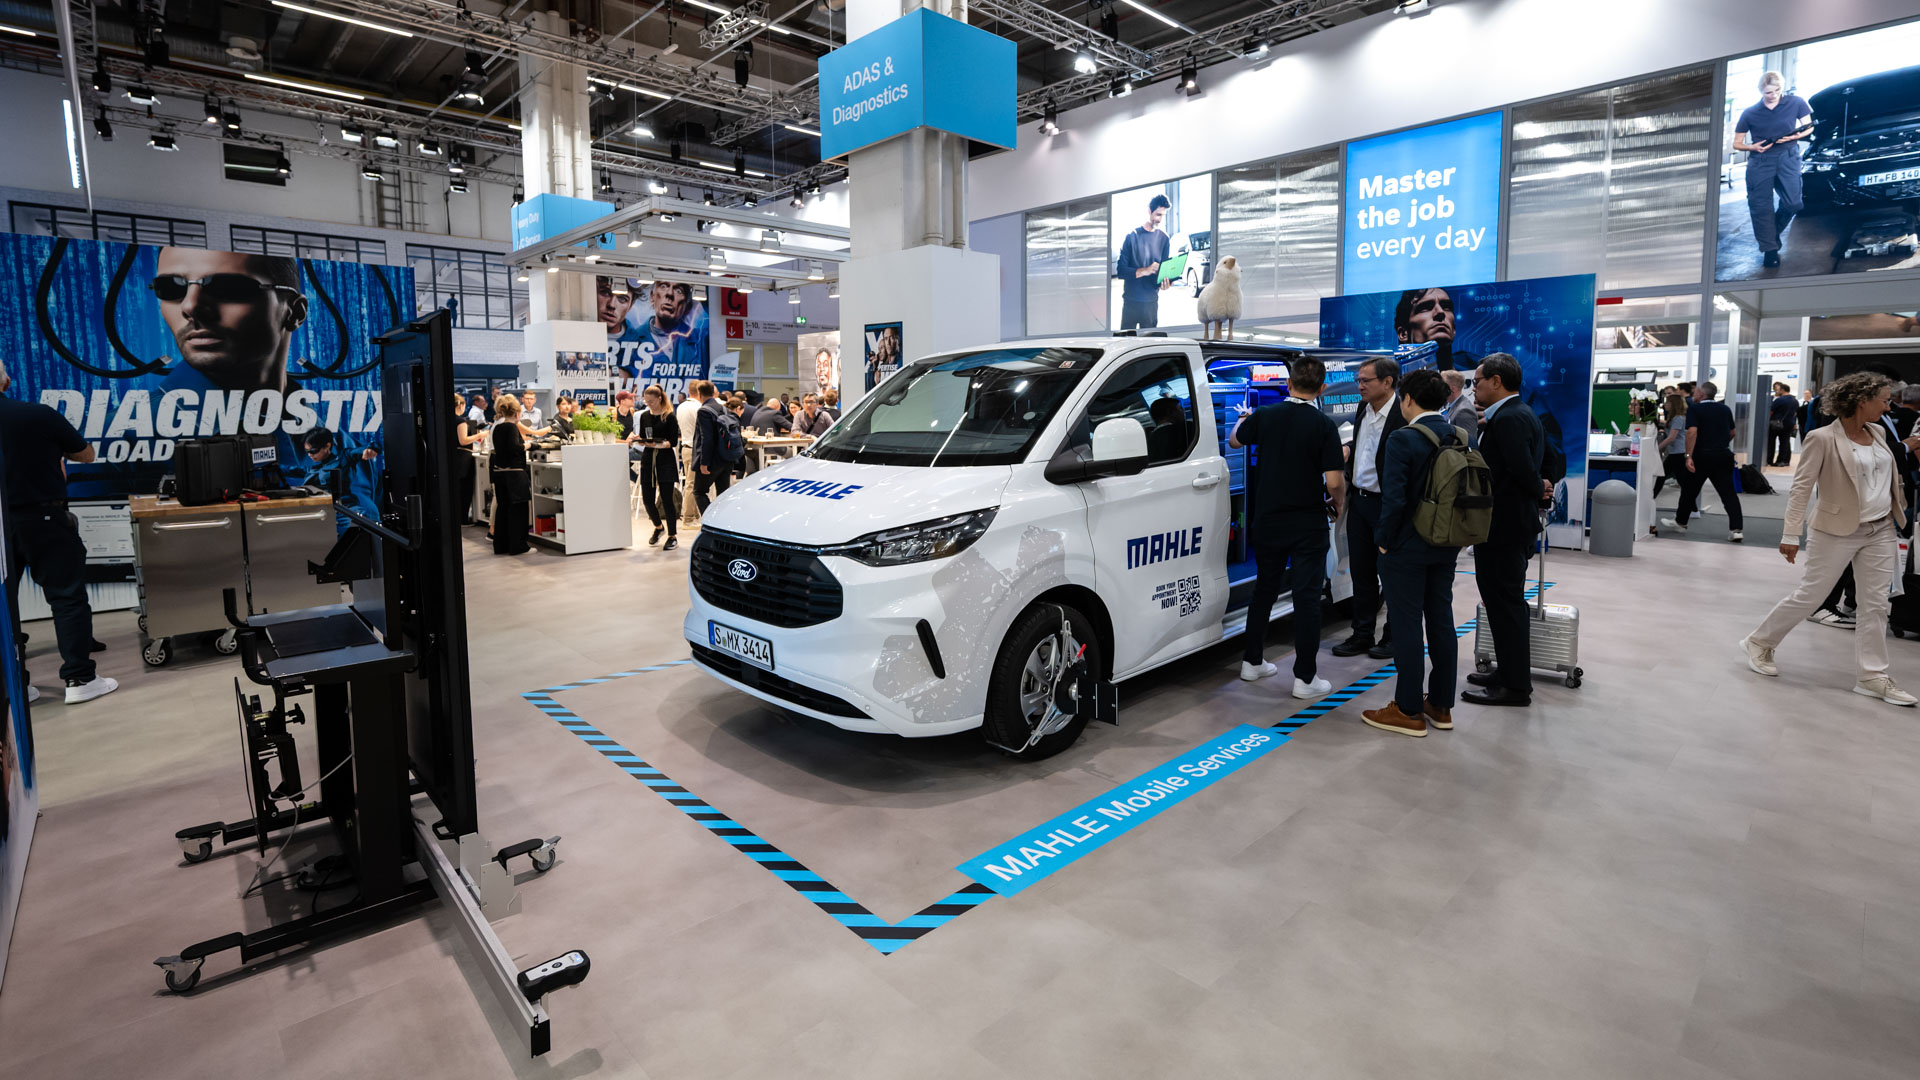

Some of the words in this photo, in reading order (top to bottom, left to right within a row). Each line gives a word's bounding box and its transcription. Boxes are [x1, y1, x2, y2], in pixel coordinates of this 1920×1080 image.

[843, 62, 881, 95] ADAS
[884, 56, 895, 76] &
[832, 83, 909, 125] Diagnostics
[1359, 166, 1457, 200] Master
[1866, 175, 1879, 184] HT
[1885, 173, 1898, 182] FB
[1357, 205, 1401, 230] the
[1407, 194, 1456, 228] job
[1356, 234, 1426, 259] every
[1434, 225, 1486, 252] day
[727, 288, 742, 311] C
[745, 329, 753, 337] 12
[607, 340, 655, 370] RTS
[651, 362, 675, 377] FOR
[678, 362, 702, 377] THE
[1332, 371, 1355, 383] CHANGE
[575, 392, 607, 401] EXPERTE
[1323, 395, 1340, 405] BRAKE
[1341, 393, 1362, 404] INSPECT
[1332, 404, 1344, 414] AND
[253, 449, 275, 461] MAHLE
[758, 477, 865, 501] MAHLE
[1127, 526, 1203, 570] MAHLE
[732, 561, 752, 579] Ford
[1151, 589, 1177, 602] APPOINTMENT
[1161, 596, 1178, 610] NOW!
[715, 626, 722, 645] S
[726, 630, 741, 653] MX
[742, 636, 770, 663] 3414
[983, 814, 1110, 882] MAHLE
[1095, 774, 1190, 822] Mobile
[1177, 732, 1271, 778] Services
